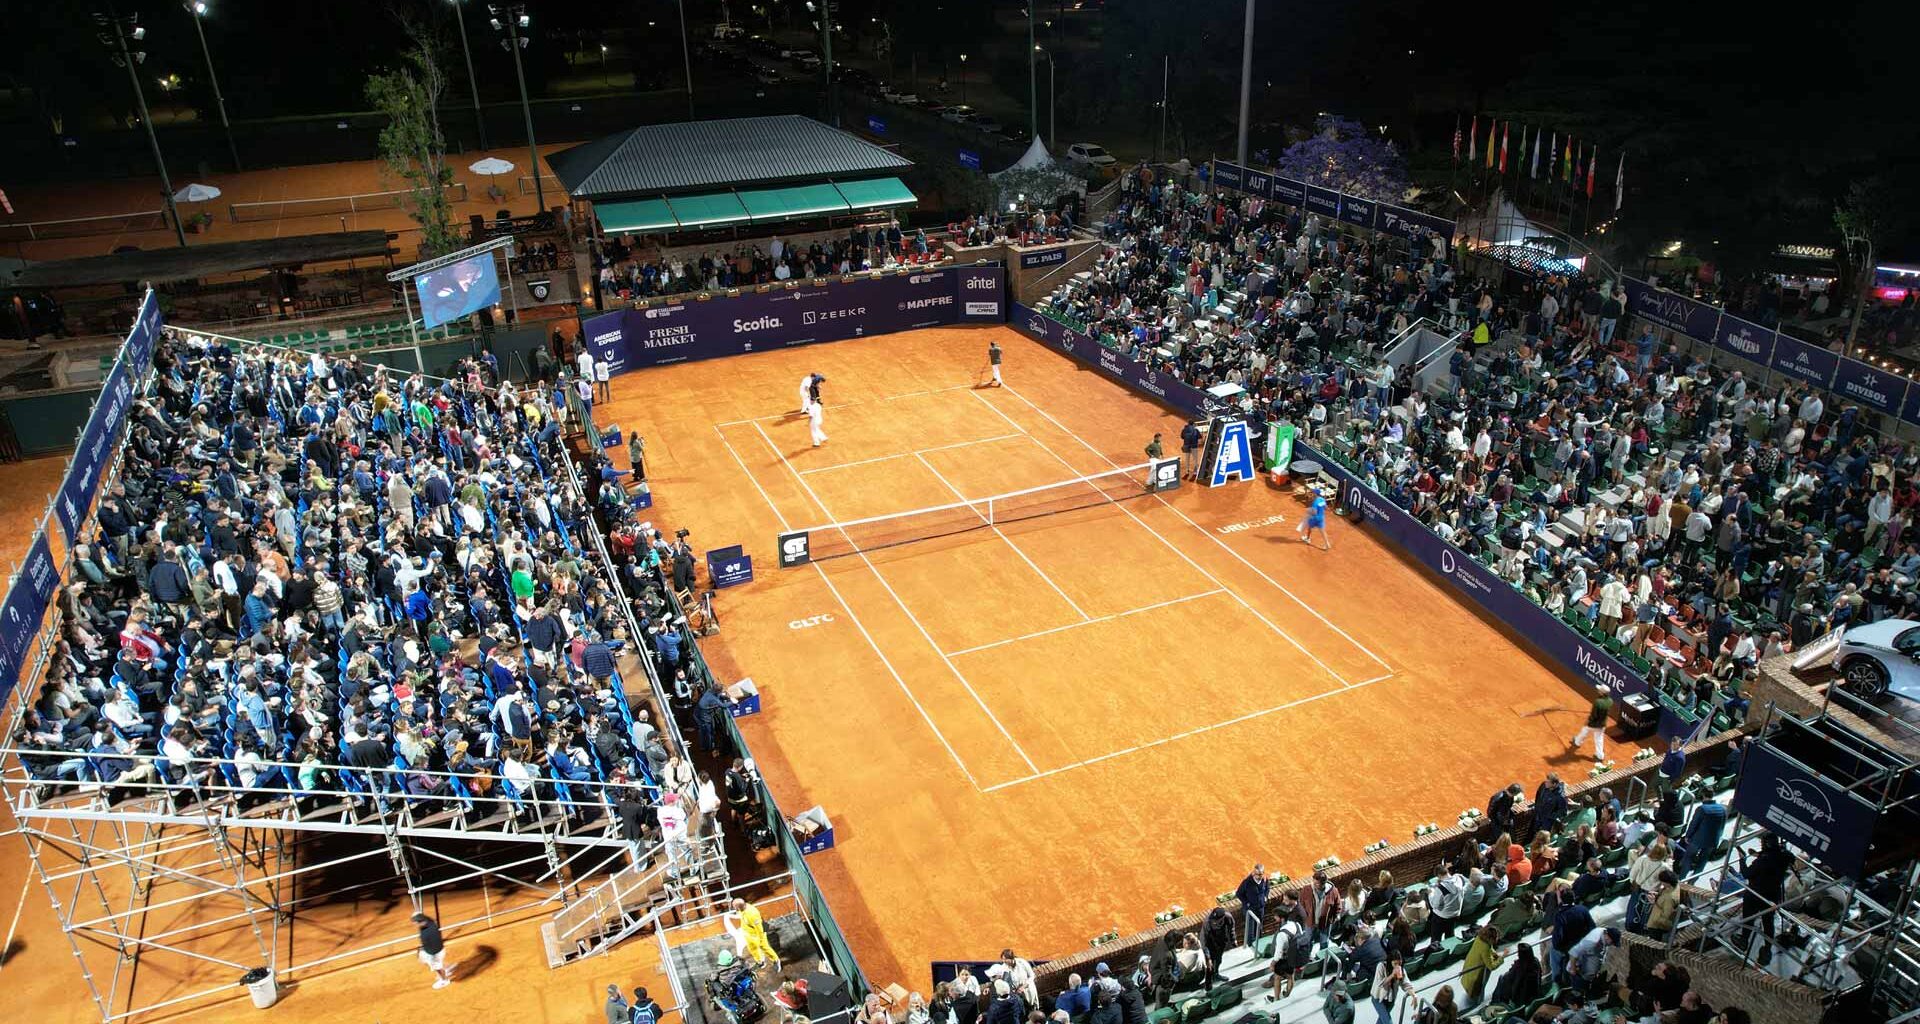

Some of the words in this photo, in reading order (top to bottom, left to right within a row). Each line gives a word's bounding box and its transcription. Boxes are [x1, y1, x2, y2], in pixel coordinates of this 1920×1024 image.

[966, 276, 996, 289] antel
[907, 295, 953, 310] MAPFRE
[819, 307, 867, 320] ZEEKR
[594, 330, 621, 343] AMERICAN
[649, 325, 689, 338] FRESH
[598, 334, 623, 347] EXPRESS
[643, 333, 697, 349] MARKET
[1139, 377, 1166, 397] PROSEGUR
[1217, 513, 1286, 535] URUGUAY
[788, 612, 835, 631] CLTC
[1575, 644, 1625, 693] Maxine
[1765, 803, 1832, 852] ESPN
